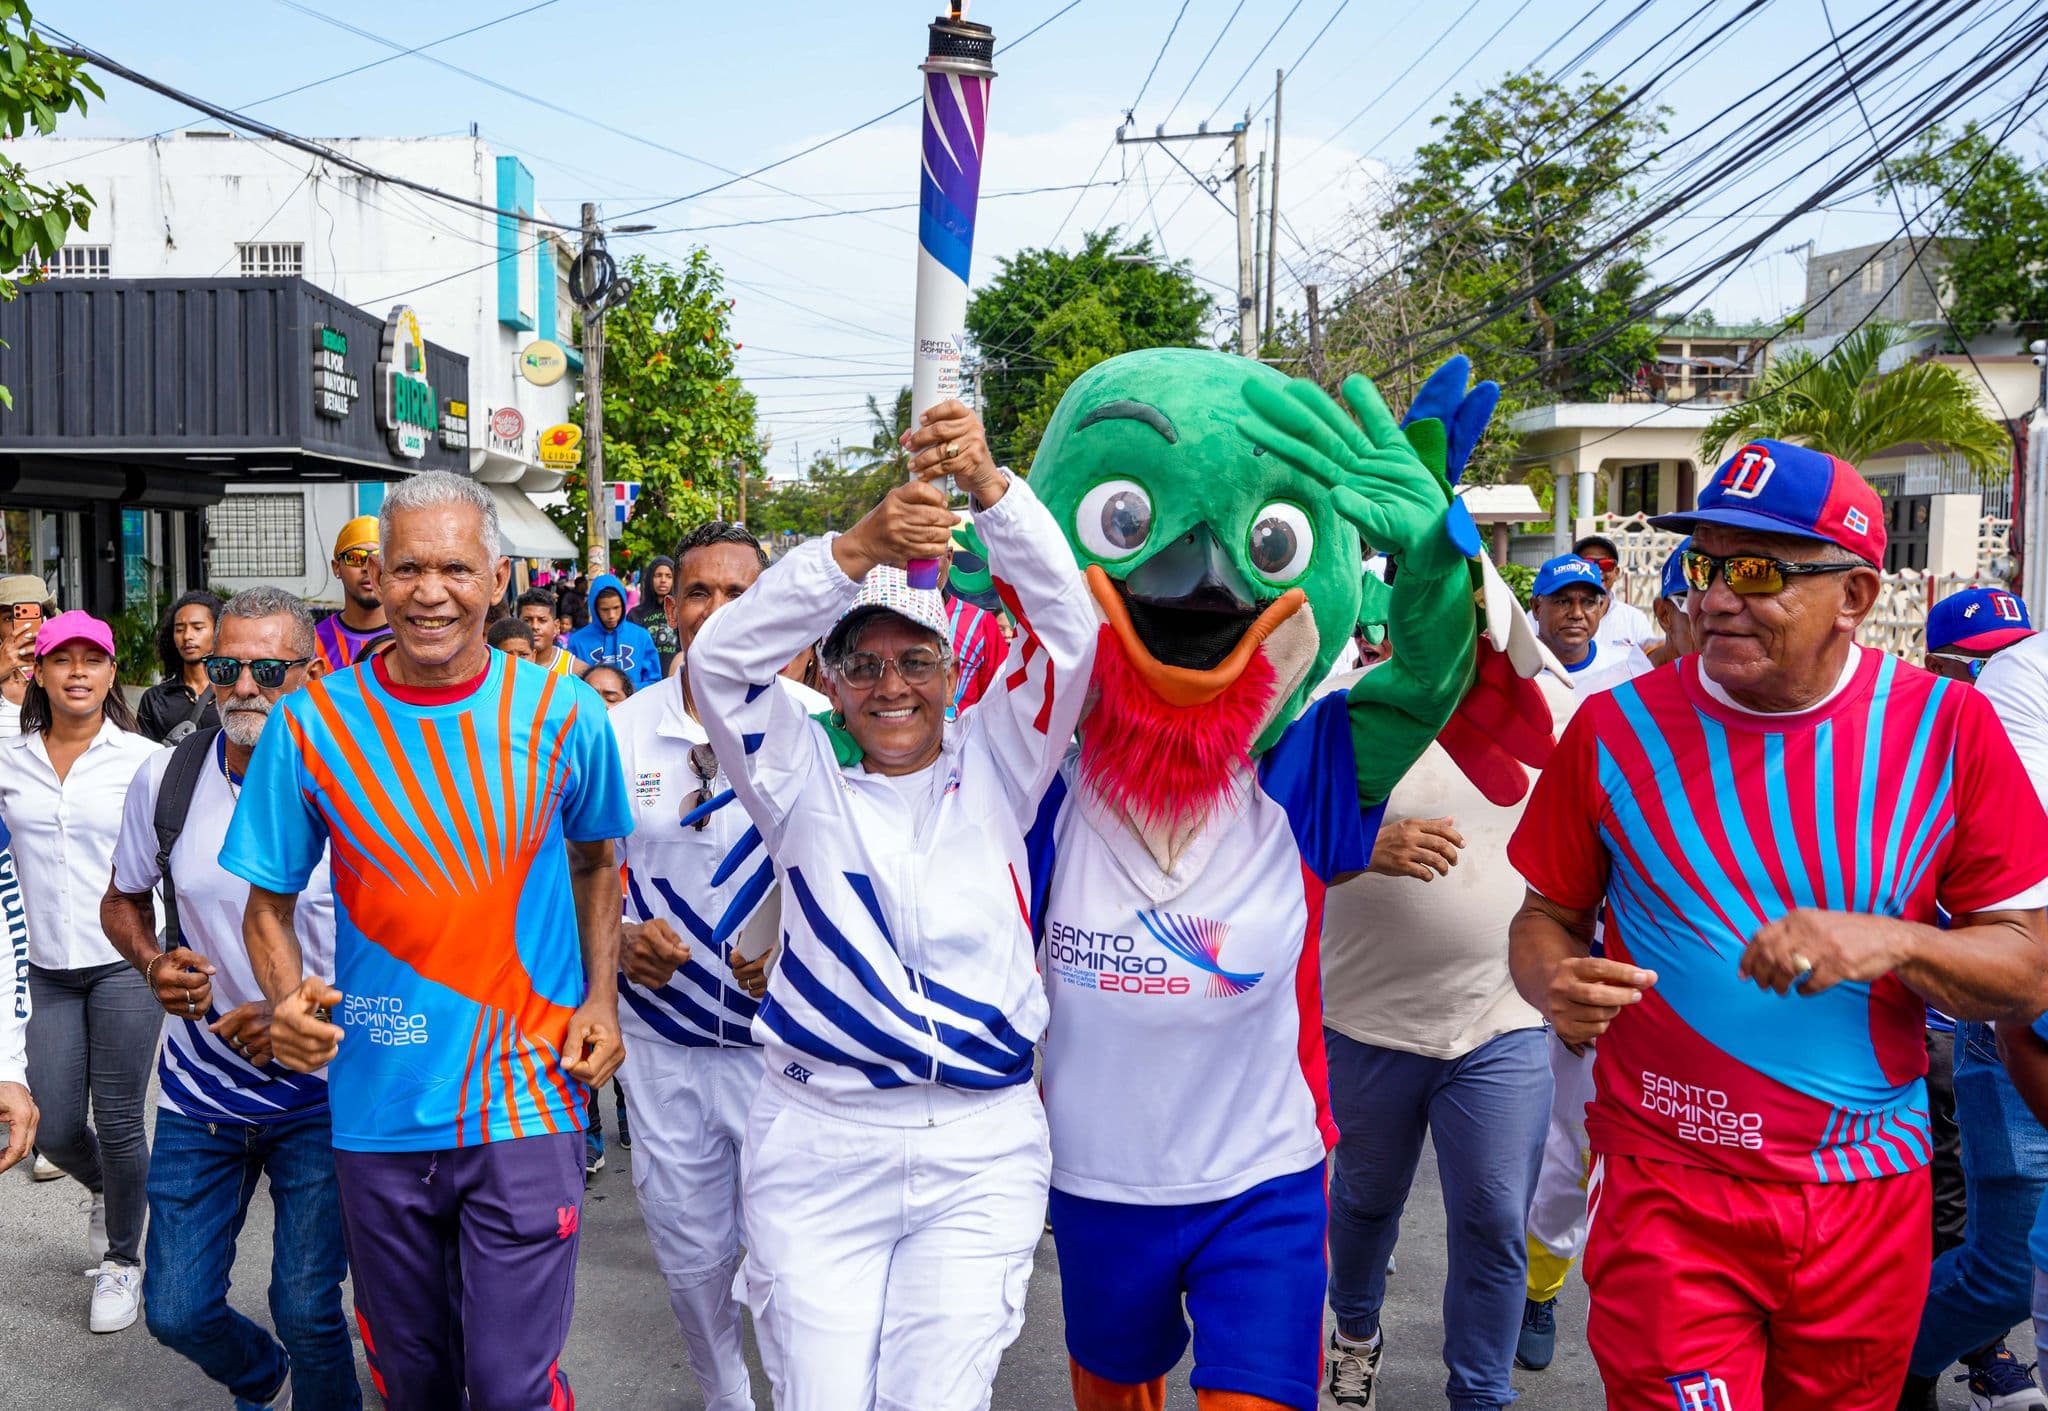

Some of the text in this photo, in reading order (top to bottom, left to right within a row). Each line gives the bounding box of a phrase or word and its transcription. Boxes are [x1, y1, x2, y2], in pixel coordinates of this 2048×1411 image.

[920, 339, 951, 349] SANTO
[920, 346, 957, 355] DOMINGO
[636, 779, 660, 787] CARIBE
[0, 853, 28, 1019] olumbia
[1051, 921, 1134, 953] SANTO
[1051, 941, 1167, 975] DOMINGO
[1100, 973, 1190, 995] 2026
[344, 993, 402, 1013] SANTO
[344, 1010, 427, 1031] DOMINGO
[369, 1028, 428, 1046] 2026
[1641, 1070, 1728, 1109] SANTO
[1641, 1090, 1763, 1131] DOMINGO
[1678, 1121, 1763, 1150] 2026
